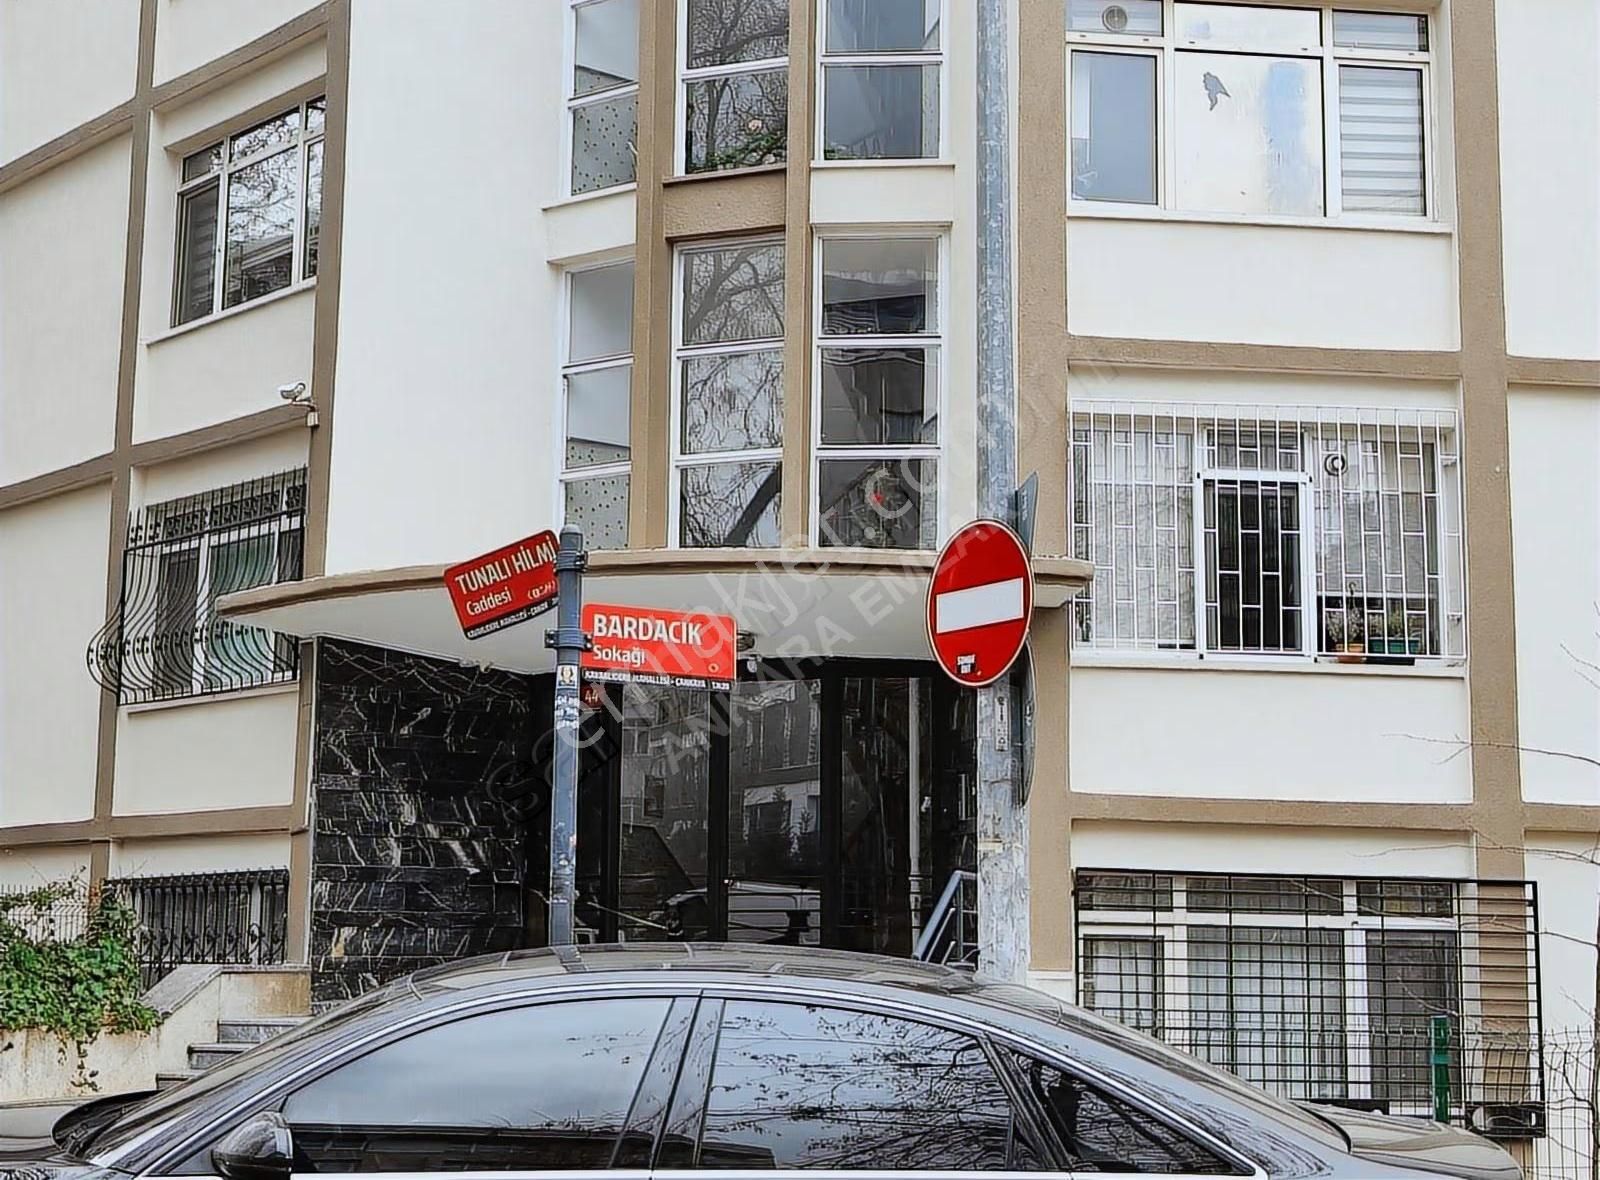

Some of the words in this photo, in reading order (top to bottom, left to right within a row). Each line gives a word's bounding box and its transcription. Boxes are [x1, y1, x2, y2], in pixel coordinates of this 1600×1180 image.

[455, 558, 513, 595] TUNALI
[511, 535, 557, 575] HİLMİ
[466, 585, 512, 616] Caddesi
[593, 613, 702, 646] BARDACIK
[592, 644, 646, 667] Sokağı
